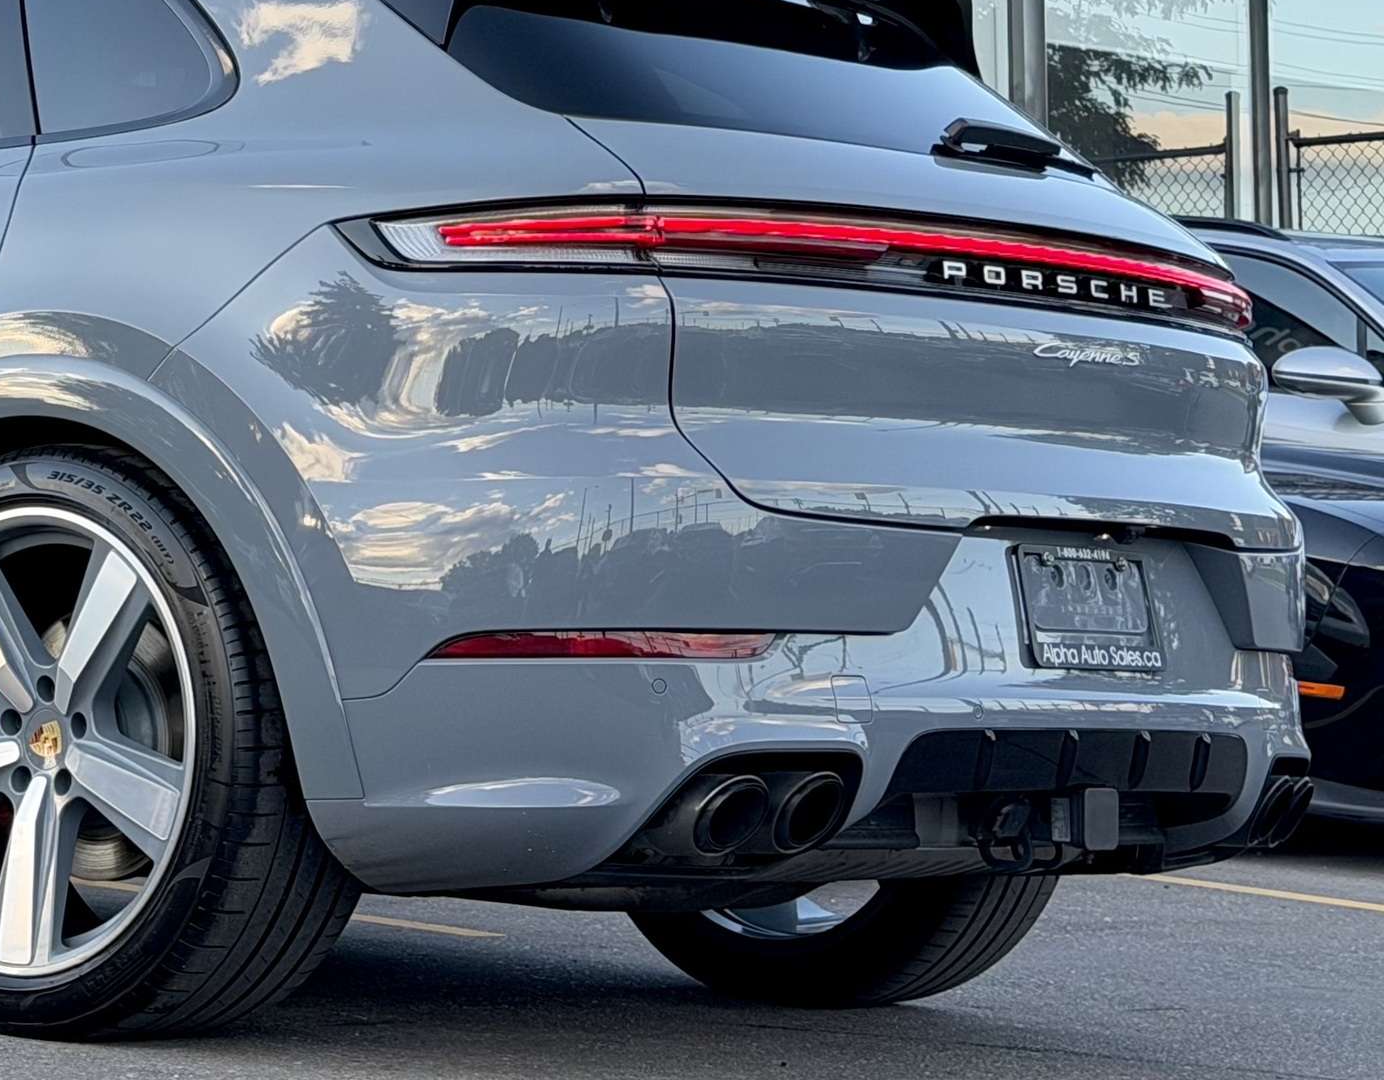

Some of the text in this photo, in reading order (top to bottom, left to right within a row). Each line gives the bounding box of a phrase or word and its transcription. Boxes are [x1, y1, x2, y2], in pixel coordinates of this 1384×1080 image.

[943, 261, 1169, 308] PORSCHE
[1033, 342, 1141, 368] Cayenne S
[46, 470, 107, 495] 315/35
[1043, 644, 1161, 667] Alpha Auto Sales.ca
